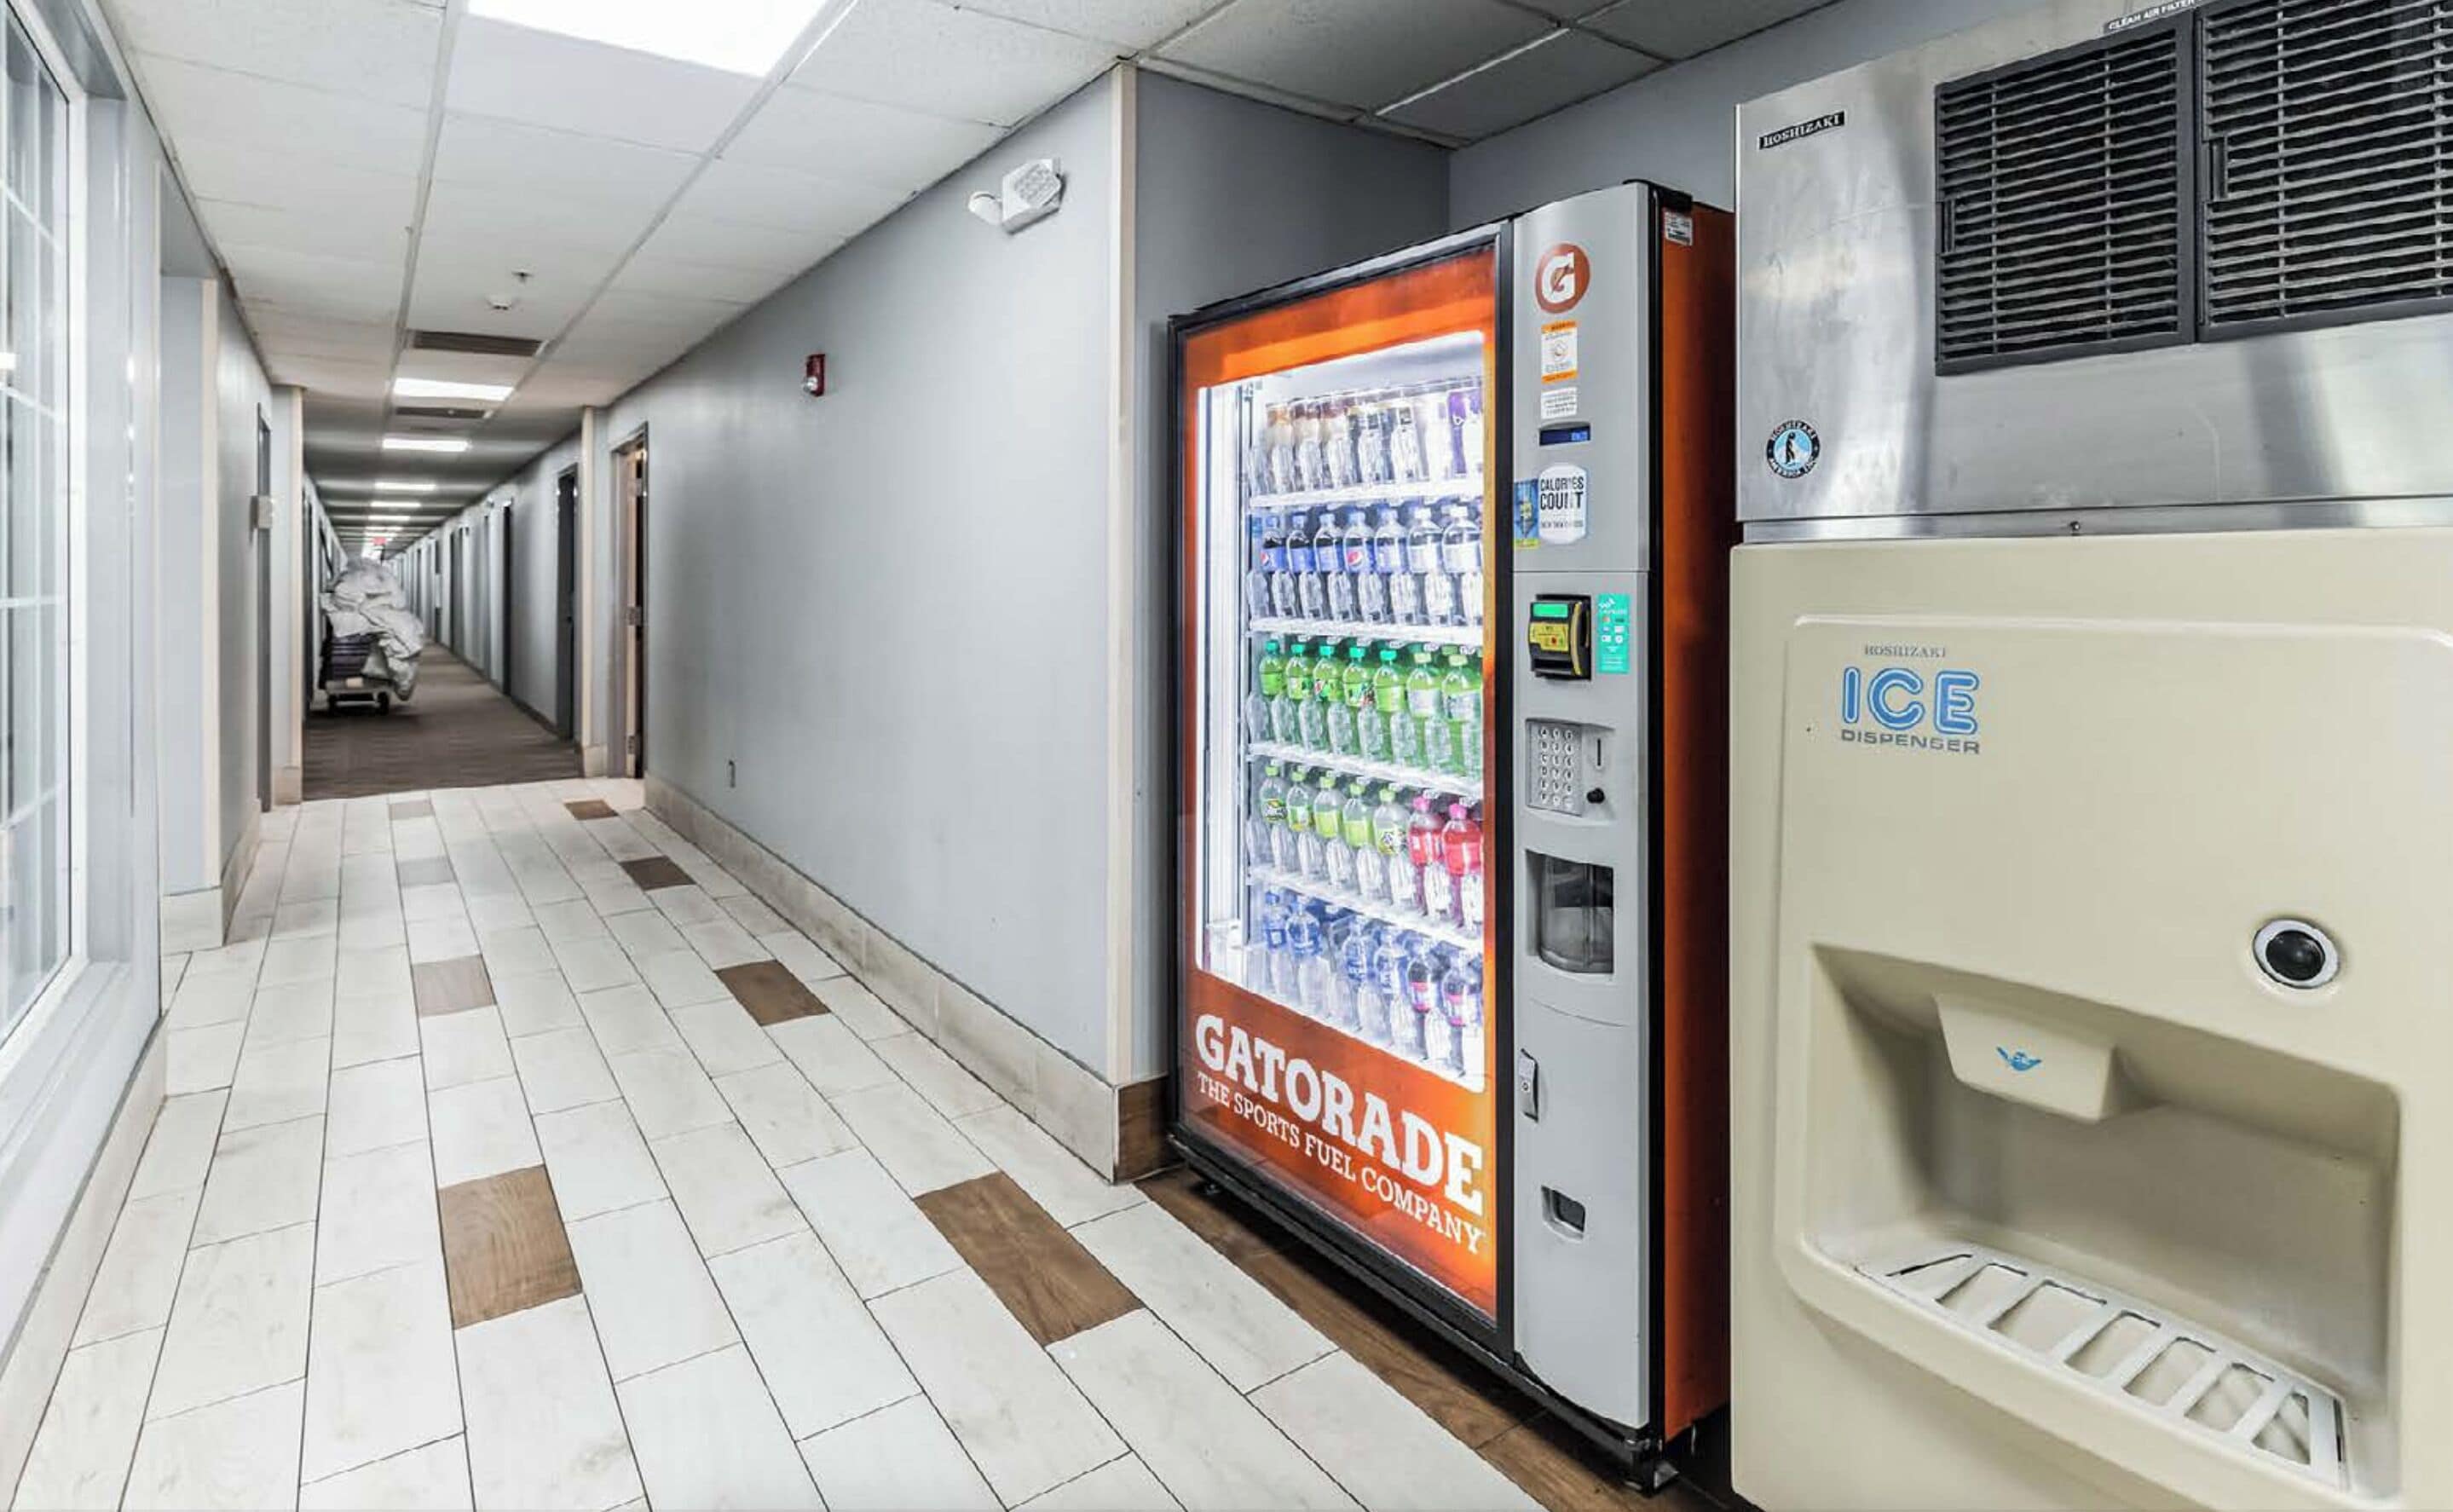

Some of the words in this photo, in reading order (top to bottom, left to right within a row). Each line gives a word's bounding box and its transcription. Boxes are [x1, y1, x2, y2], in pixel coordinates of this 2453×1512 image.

[2108, 14, 2142, 30] CLEAN
[2143, 8, 2160, 19] AIR
[1763, 114, 1839, 147] HOSHIZAKI
[1864, 644, 1947, 658] HOSHIZAKI
[1842, 666, 1980, 736] ICE
[1840, 729, 1980, 755] DISPENSER
[1196, 1013, 1484, 1217] GATORADE
[1198, 1071, 1230, 1109] THE
[1233, 1091, 1301, 1149] SPORTS
[1305, 1131, 1357, 1182] FUEL
[1360, 1166, 1486, 1255] COMPANY
